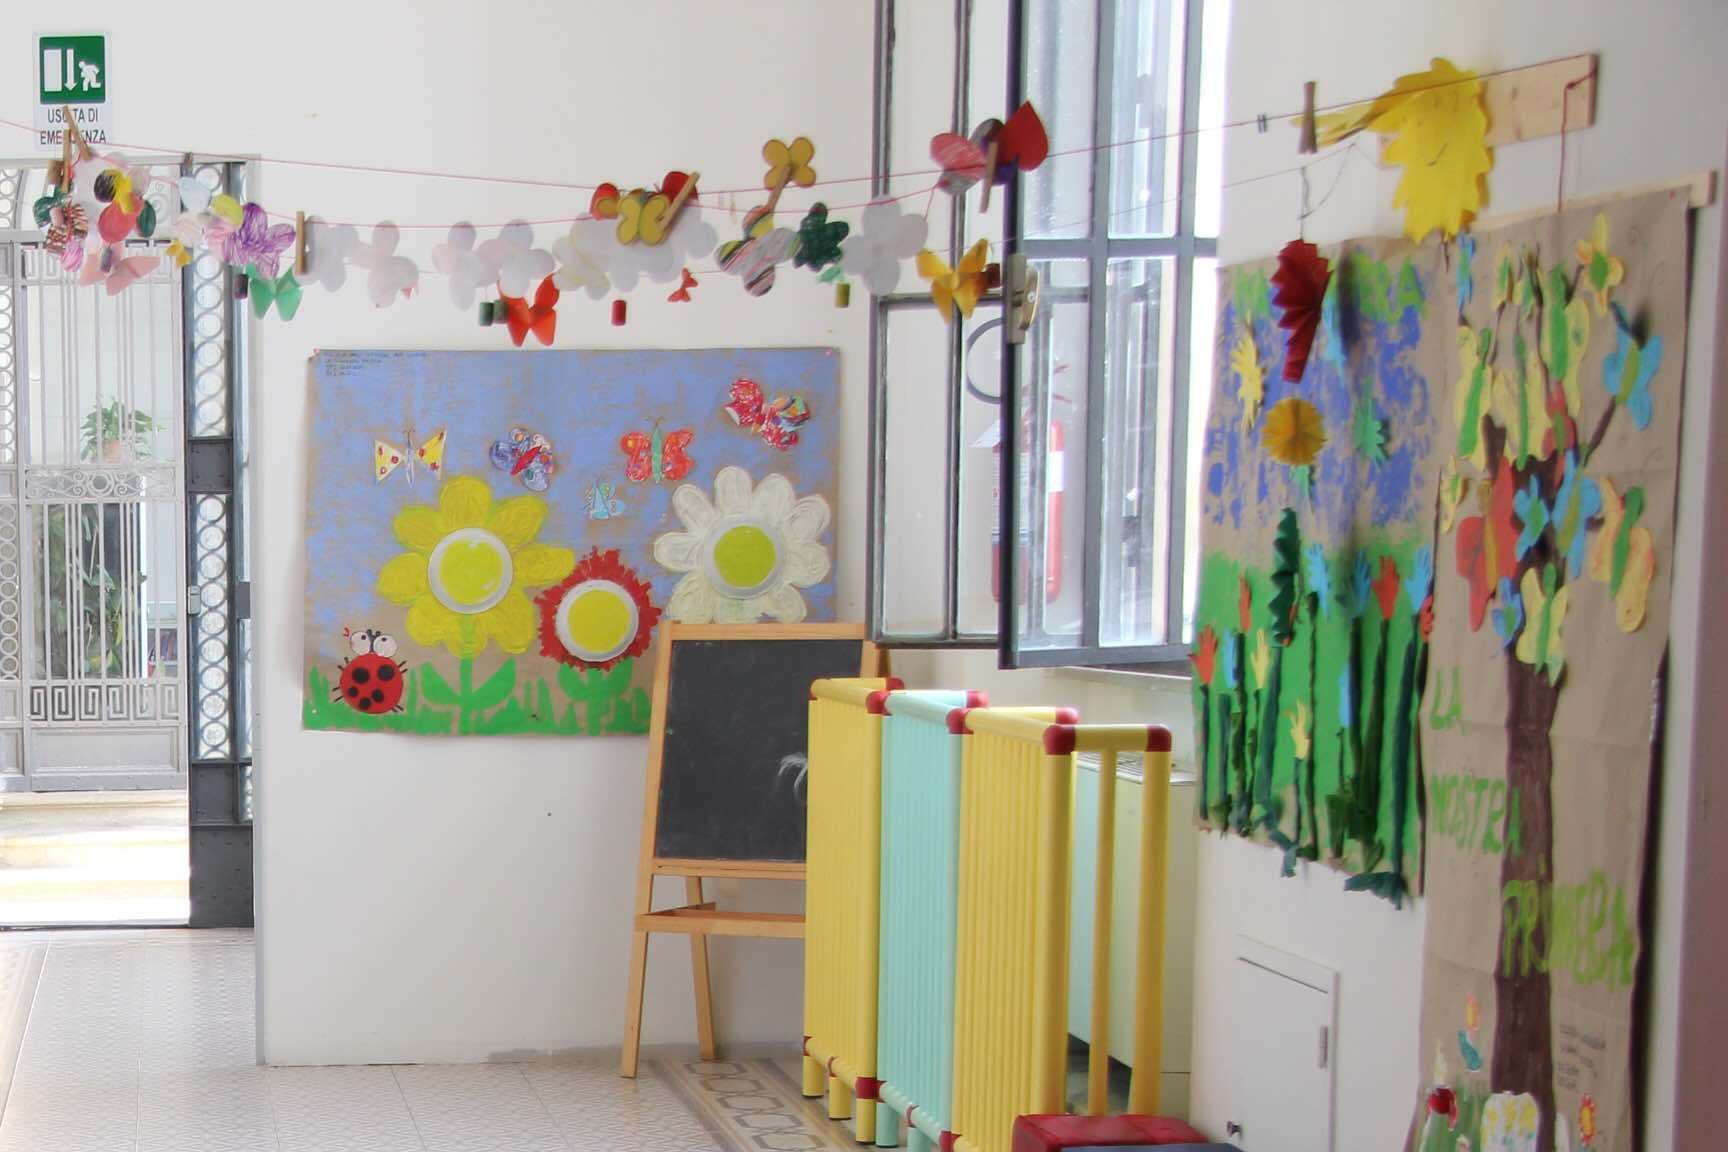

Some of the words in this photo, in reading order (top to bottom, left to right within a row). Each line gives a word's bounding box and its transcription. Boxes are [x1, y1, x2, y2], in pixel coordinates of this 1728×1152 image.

[48, 108, 86, 123] USCTA
[88, 108, 99, 122] DI
[40, 130, 106, 145] EMEENZA
[1430, 772, 1523, 856] NOSTRA
